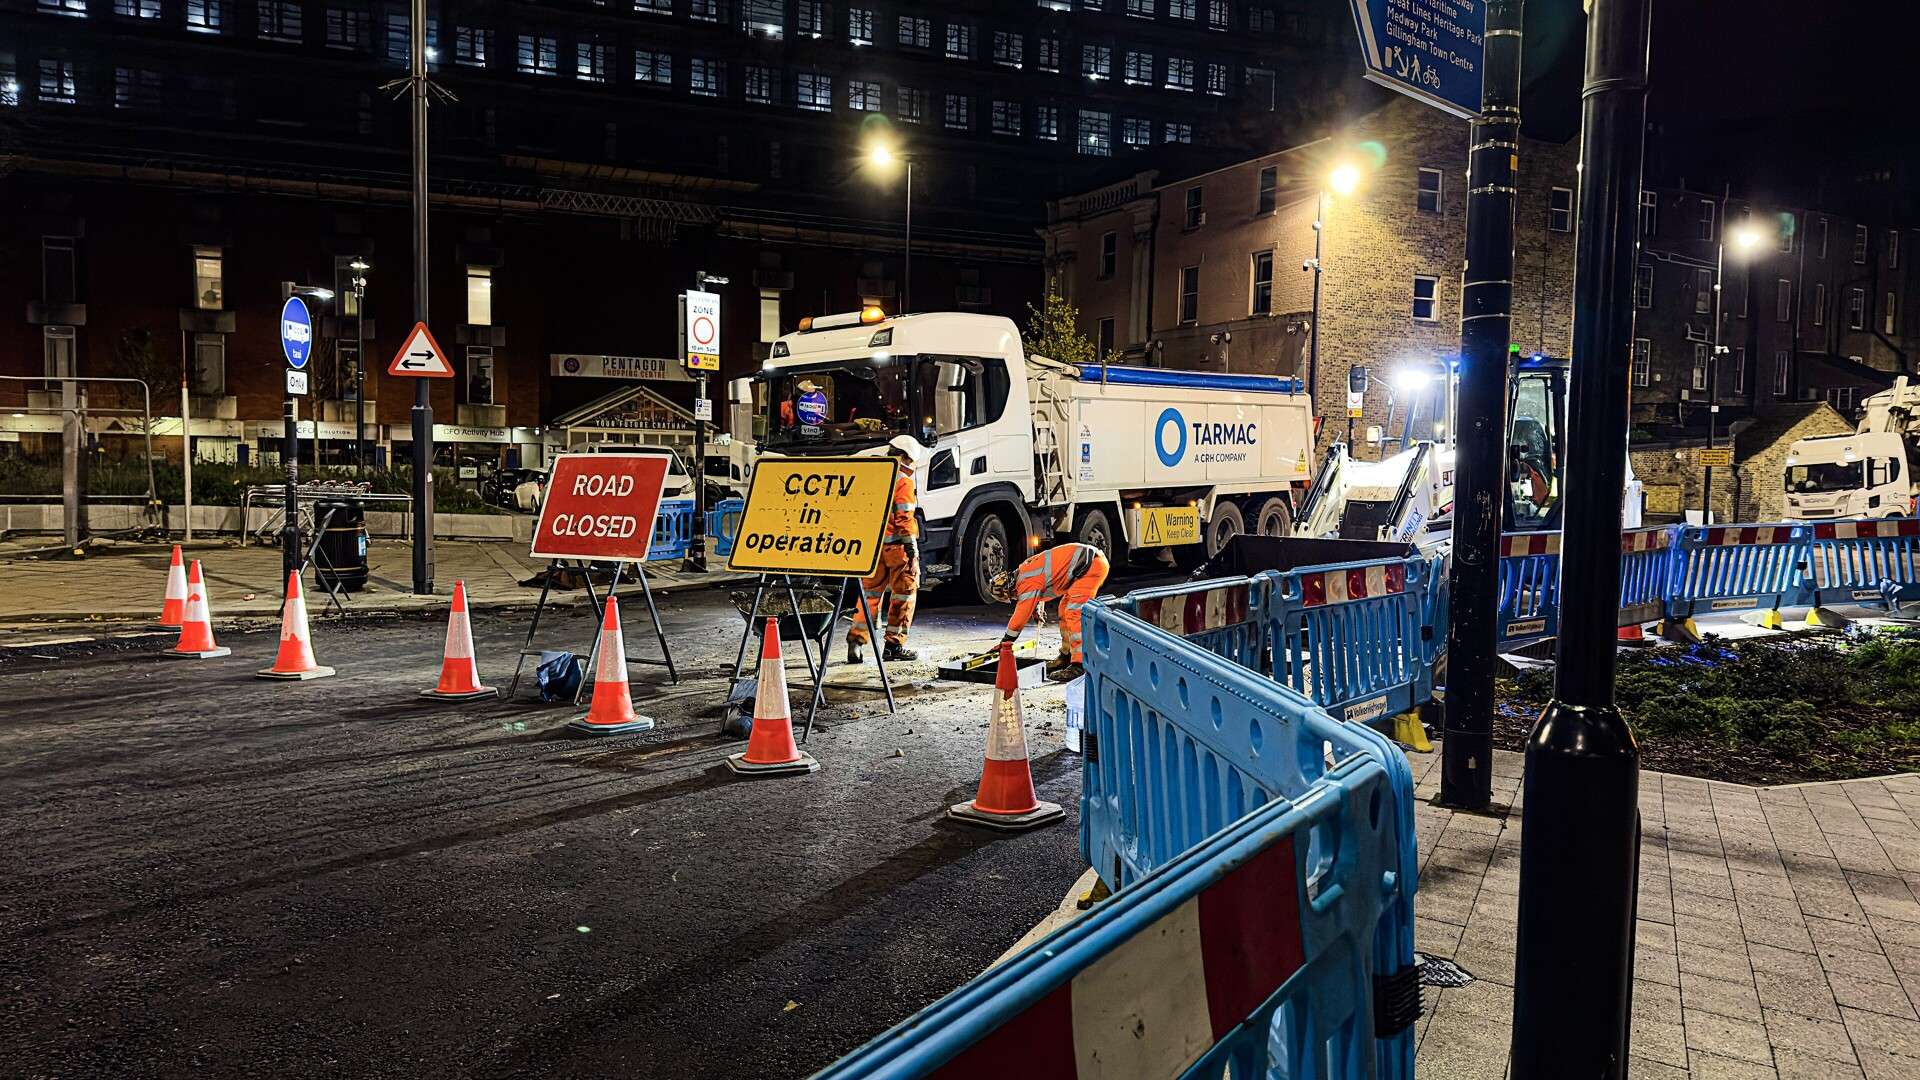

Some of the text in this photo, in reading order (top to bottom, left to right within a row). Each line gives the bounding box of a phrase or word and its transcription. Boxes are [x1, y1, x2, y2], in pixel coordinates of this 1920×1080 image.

[1387, 5, 1438, 41] Medway Park
[1412, 2, 1432, 21] Lines
[1433, 13, 1465, 38] Heritage
[1466, 29, 1482, 46] Park
[1386, 21, 1474, 72] Gillingham Town Centre
[693, 306, 714, 315] ZONE
[602, 357, 666, 371] PENTAGON
[602, 368, 666, 379] SHOPPING CENTRE
[290, 376, 305, 390] Only
[461, 429, 488, 438] Activity
[652, 422, 686, 430] CHATHAM
[1192, 422, 1257, 446] TARMAC
[1194, 452, 1247, 463] A CRH COMPANY
[572, 474, 634, 497] ROAD
[784, 473, 856, 497] CCTV
[799, 503, 822, 524] in
[1165, 513, 1194, 528] Warning
[552, 513, 637, 538] CLOSED
[1166, 528, 1194, 539] Keep Clear
[745, 532, 862, 555] operation
